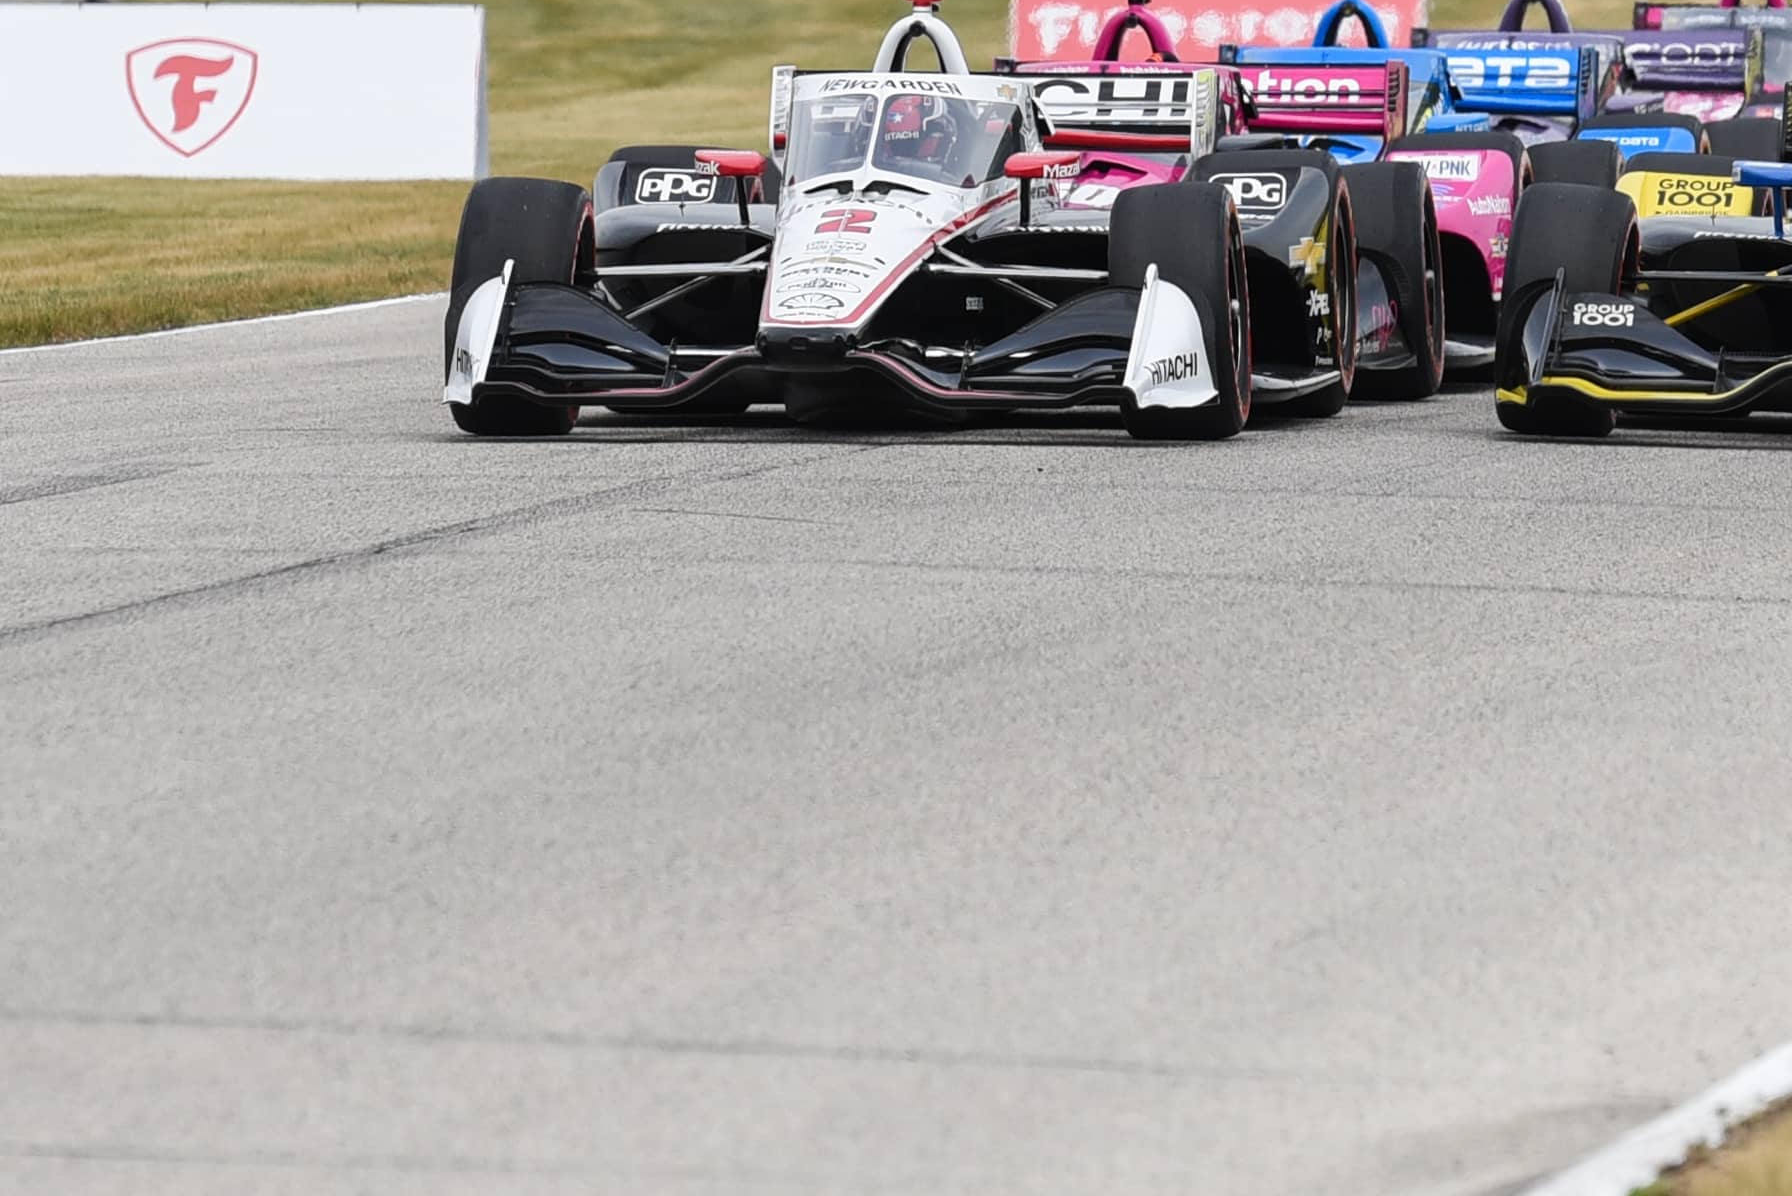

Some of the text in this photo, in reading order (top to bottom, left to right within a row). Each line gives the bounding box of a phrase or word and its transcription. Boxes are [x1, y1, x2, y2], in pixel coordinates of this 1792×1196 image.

[153, 54, 235, 133] F
[819, 78, 963, 96] NEWGARDEN
[641, 173, 712, 201] PPG
[1226, 177, 1281, 205] PG
[1658, 178, 1735, 192] GROUP
[1657, 190, 1734, 208] 1001
[814, 209, 878, 235] 2
[1573, 302, 1635, 314] GROUP
[1573, 312, 1634, 327] 1001
[1148, 351, 1198, 386] HITACHI
